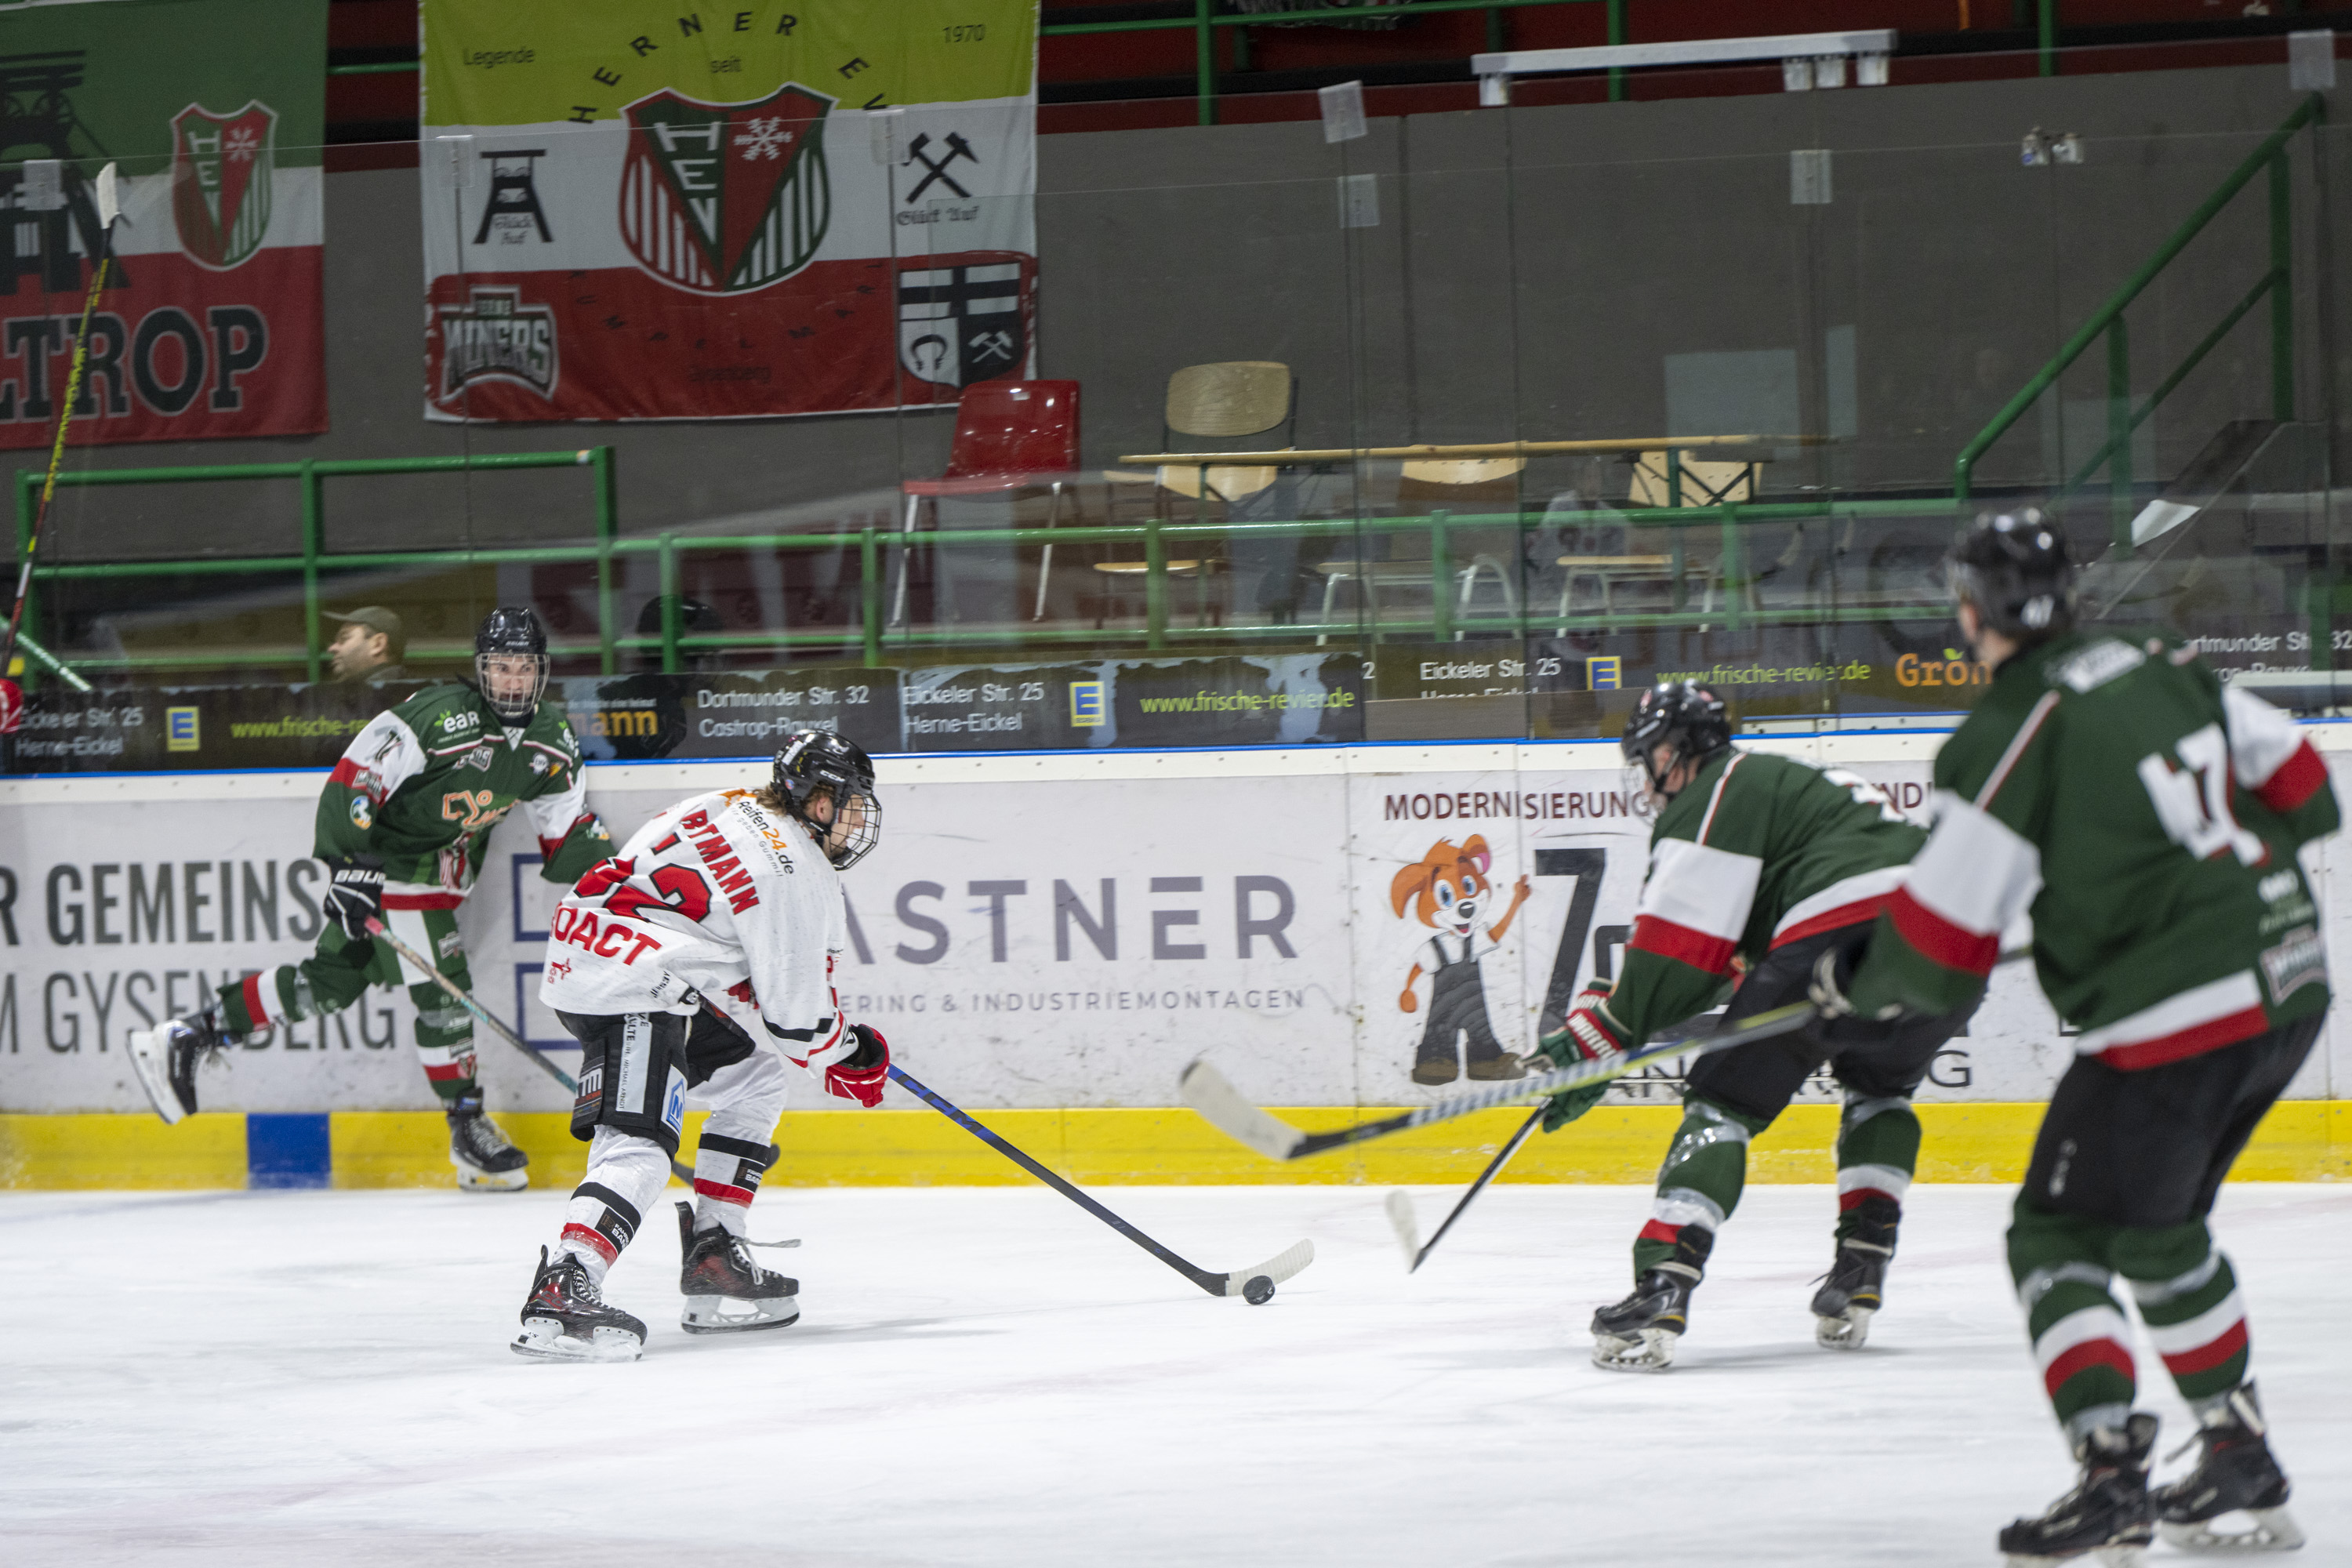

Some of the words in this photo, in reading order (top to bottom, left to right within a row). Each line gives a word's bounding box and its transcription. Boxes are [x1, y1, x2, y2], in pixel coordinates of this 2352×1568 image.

[942, 24, 985, 43] 1970
[463, 46, 535, 68] Legende
[710, 56, 742, 74] seit
[1420, 661, 1494, 681] Eickeler
[1498, 659, 1532, 677] Str.
[1536, 657, 1561, 676] 25
[697, 688, 804, 709] Dortmunder
[808, 686, 840, 706] Str.
[846, 684, 869, 704] 32
[903, 684, 977, 706] Eickeler
[982, 682, 1014, 702] Str.
[1020, 681, 1044, 702] 25
[1140, 686, 1355, 713] www.frische-revier.de
[120, 706, 143, 727] 25
[905, 712, 1022, 735] Herne-Eickel
[1385, 790, 1650, 822] MODERNISIERUNG
[738, 800, 794, 876] Reifen24.de
[46, 858, 320, 946] GEMEINS
[550, 906, 663, 967] OACT
[942, 993, 958, 1013] &
[972, 989, 1305, 1014] INDUSTRIEMONTAGEN
